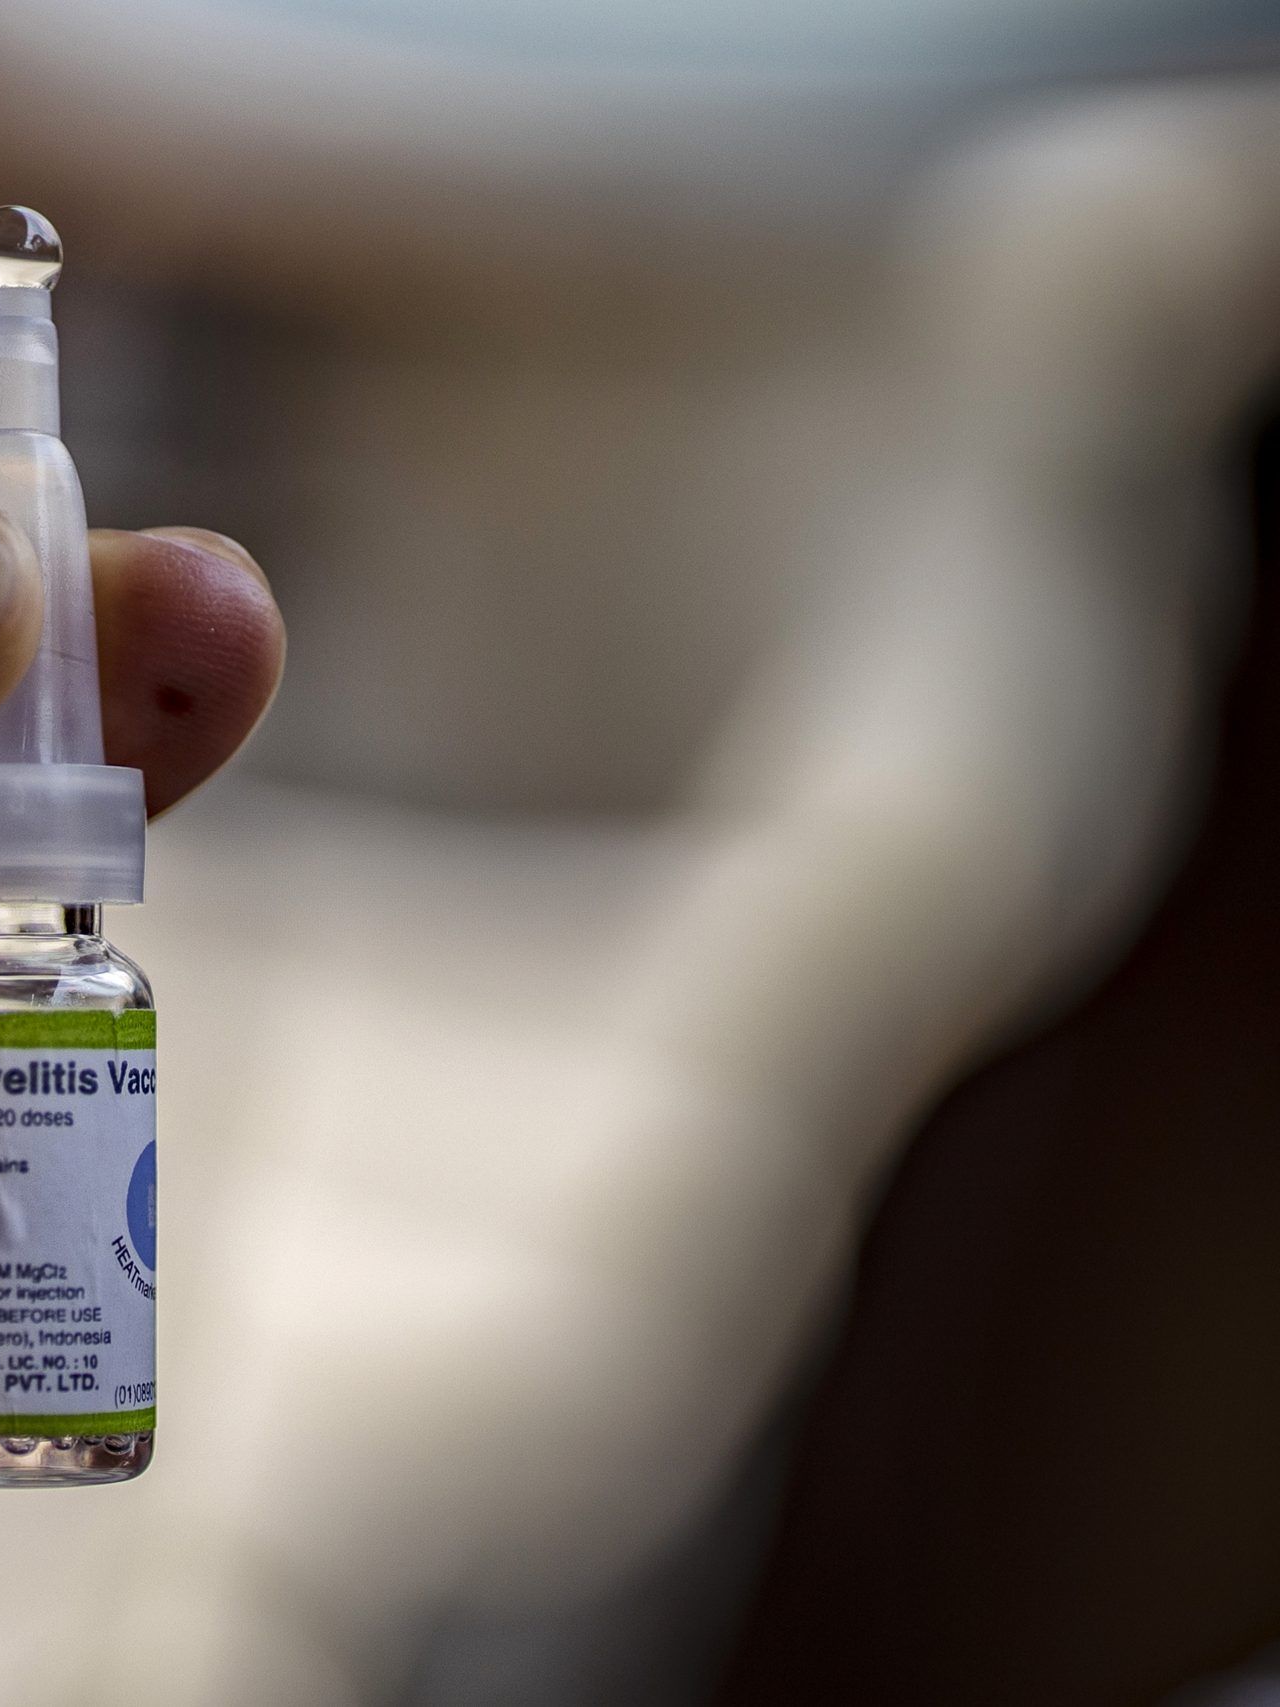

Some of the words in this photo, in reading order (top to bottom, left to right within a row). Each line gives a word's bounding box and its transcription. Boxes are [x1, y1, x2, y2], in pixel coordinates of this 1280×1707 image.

[21, 1108, 74, 1127] doses
[16, 1285, 85, 1303] injection
[71, 1307, 102, 1323] USE
[39, 1329, 111, 1346] Indonesia
[42, 1354, 70, 1370] NO.
[82, 1354, 98, 1370] 10
[4, 1374, 52, 1393] PVT.
[58, 1374, 100, 1392] LTD.
